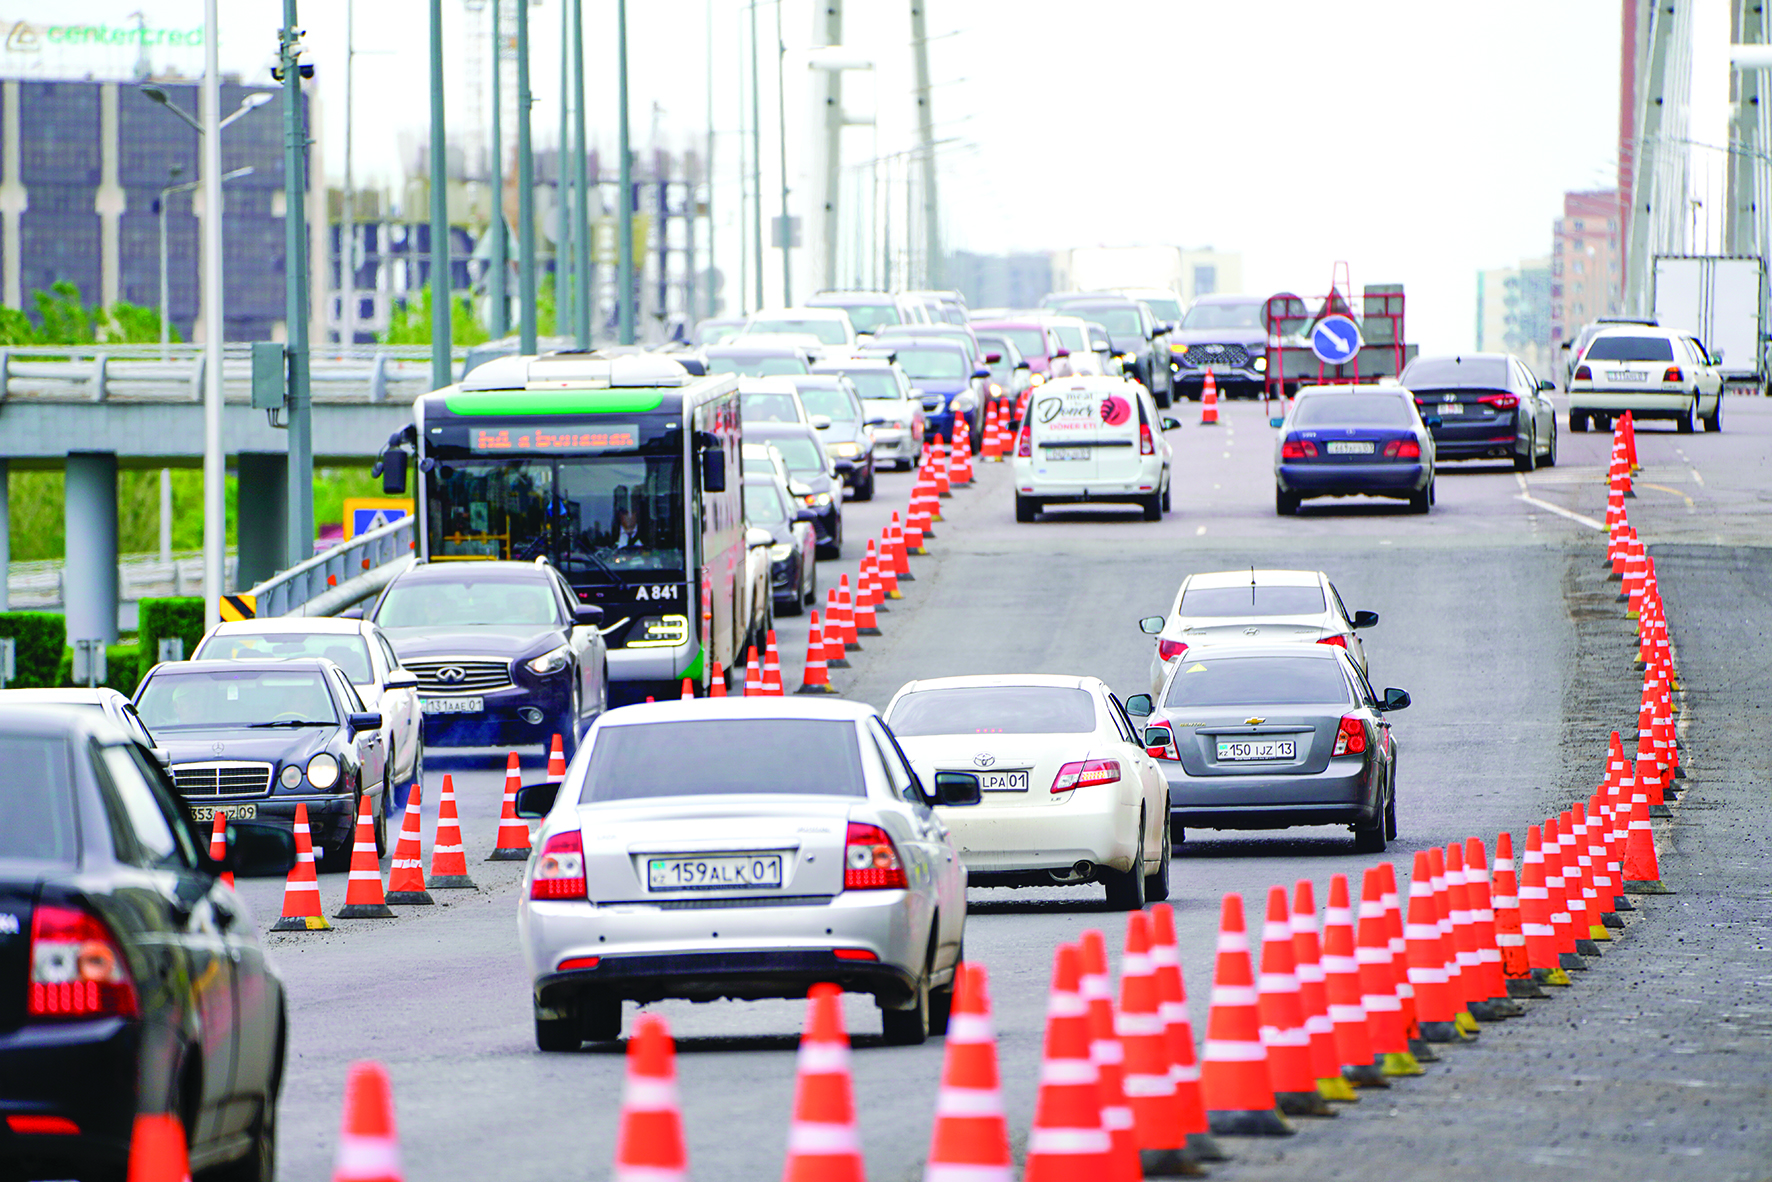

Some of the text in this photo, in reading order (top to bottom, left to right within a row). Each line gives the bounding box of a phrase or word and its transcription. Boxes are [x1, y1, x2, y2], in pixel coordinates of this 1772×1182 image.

[47, 23, 222, 46] centercred
[635, 585, 678, 600] A 841
[1229, 742, 1292, 756] 150 IJZ 13
[975, 774, 1025, 788] LPA 01
[239, 806, 254, 819] 09
[671, 860, 777, 883] 159ALK 01
